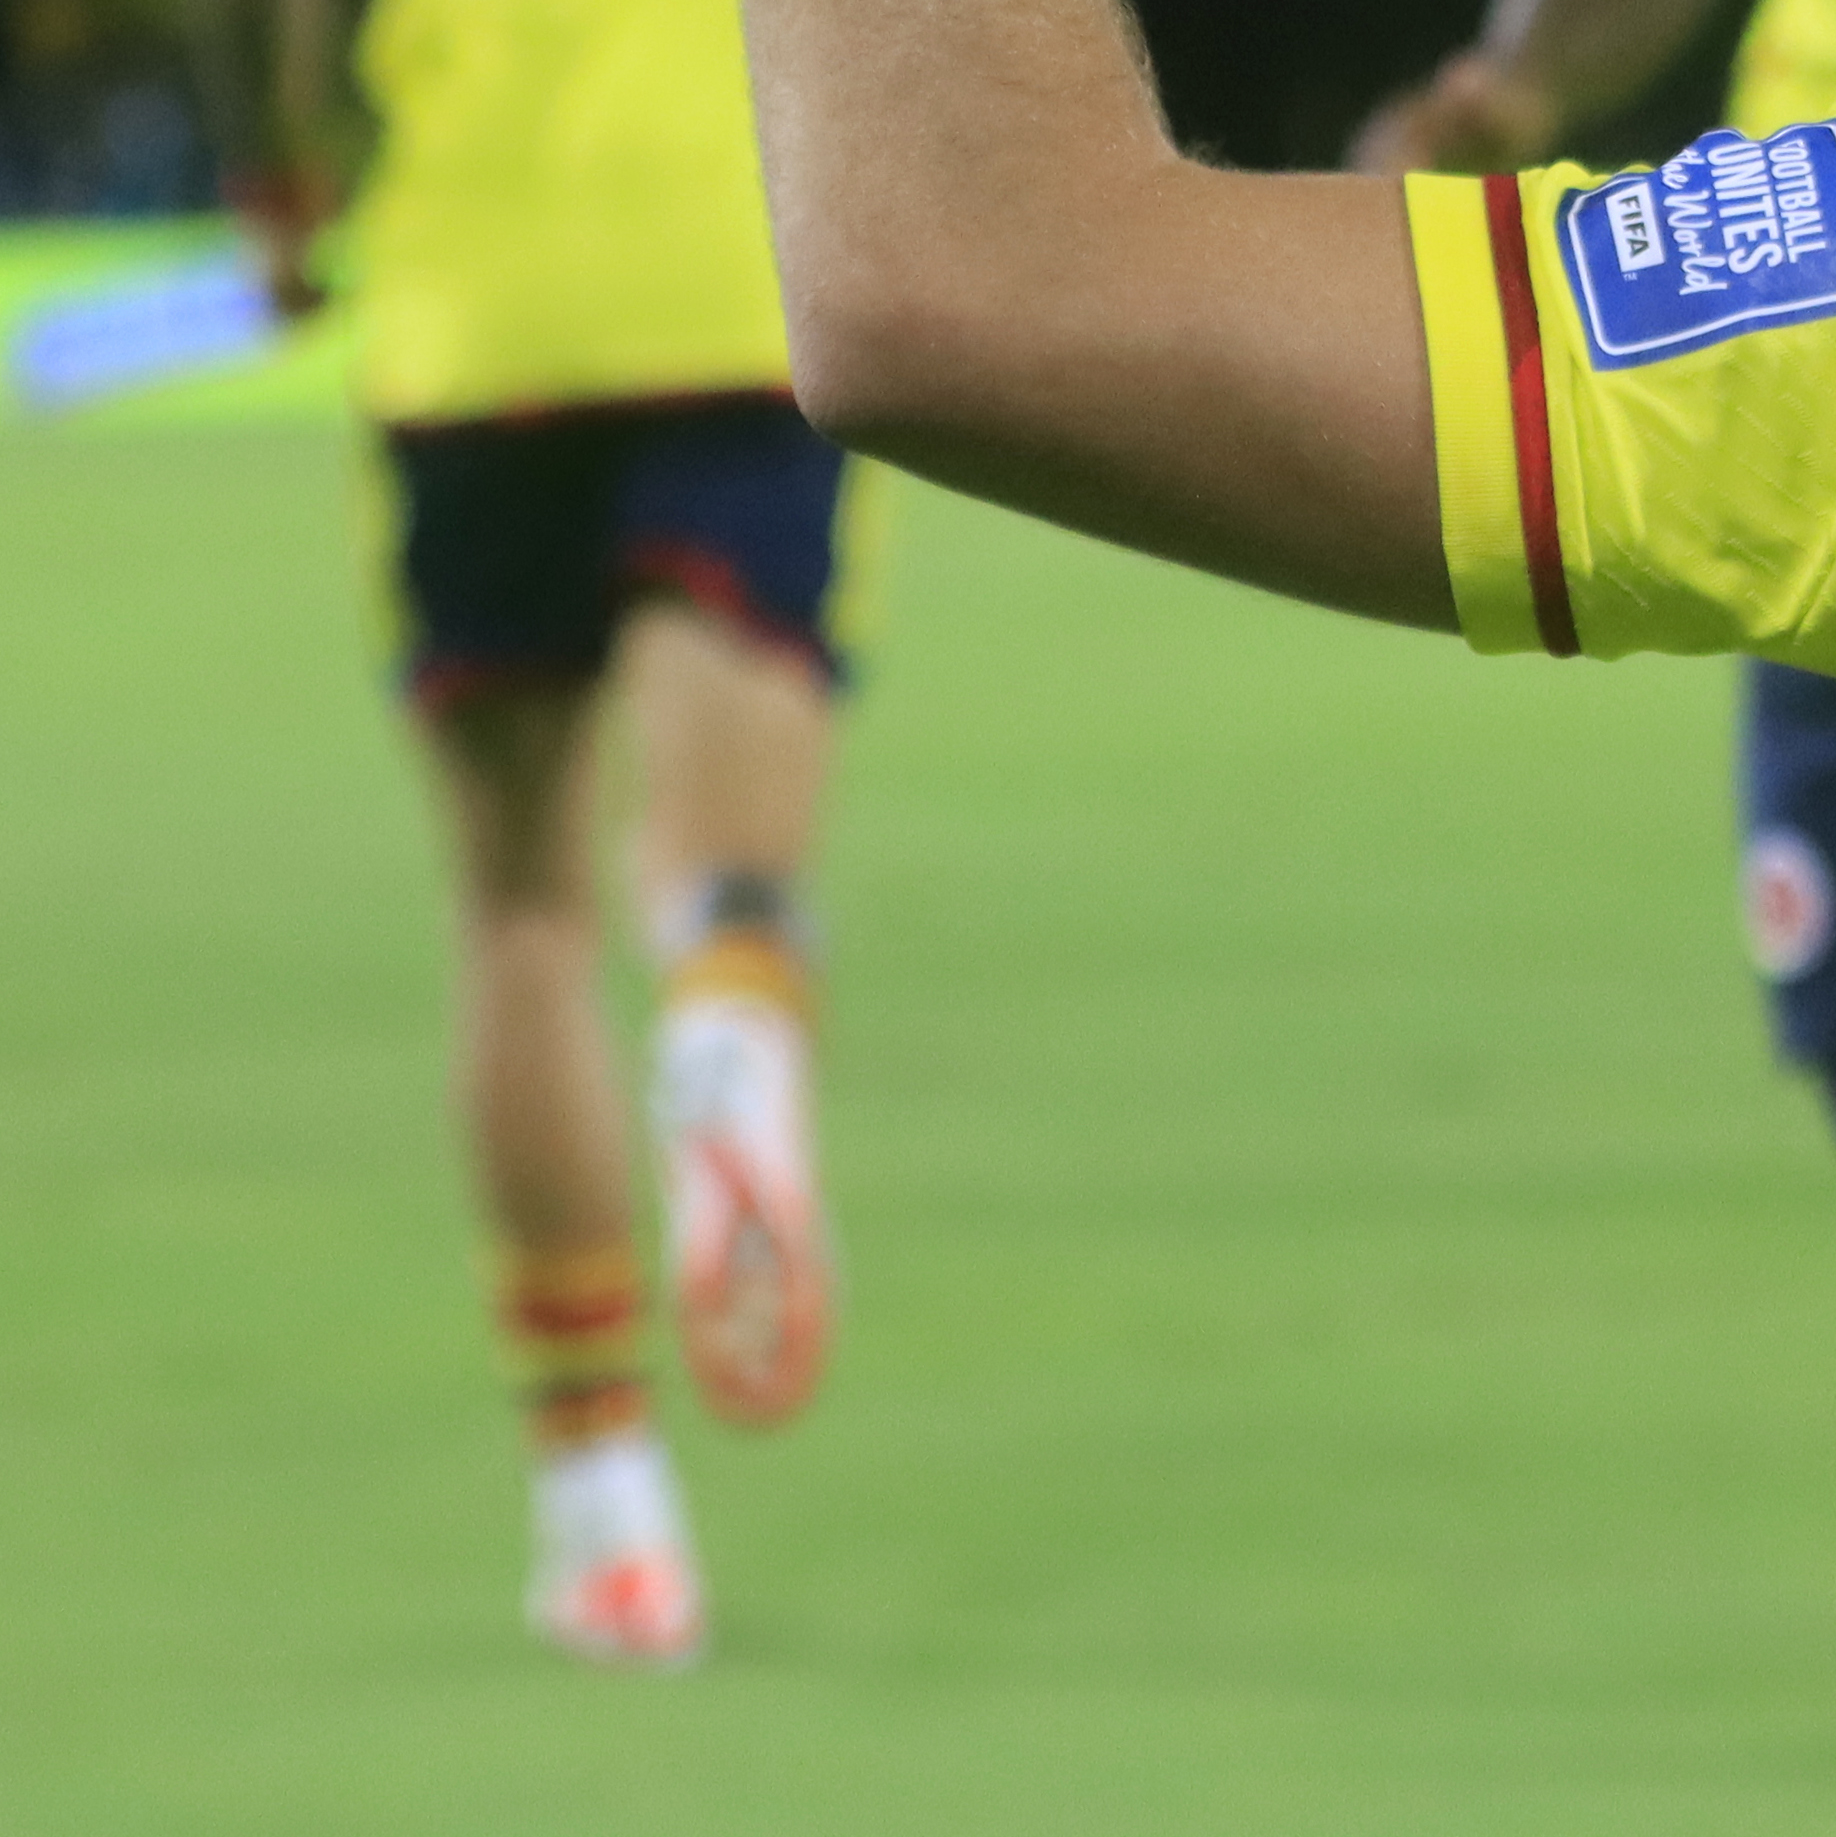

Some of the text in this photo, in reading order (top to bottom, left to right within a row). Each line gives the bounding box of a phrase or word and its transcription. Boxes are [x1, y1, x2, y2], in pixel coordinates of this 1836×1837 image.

[1618, 195, 1650, 258] FIFA
[1663, 191, 1728, 296] World
[1707, 143, 1784, 274] UNITES
